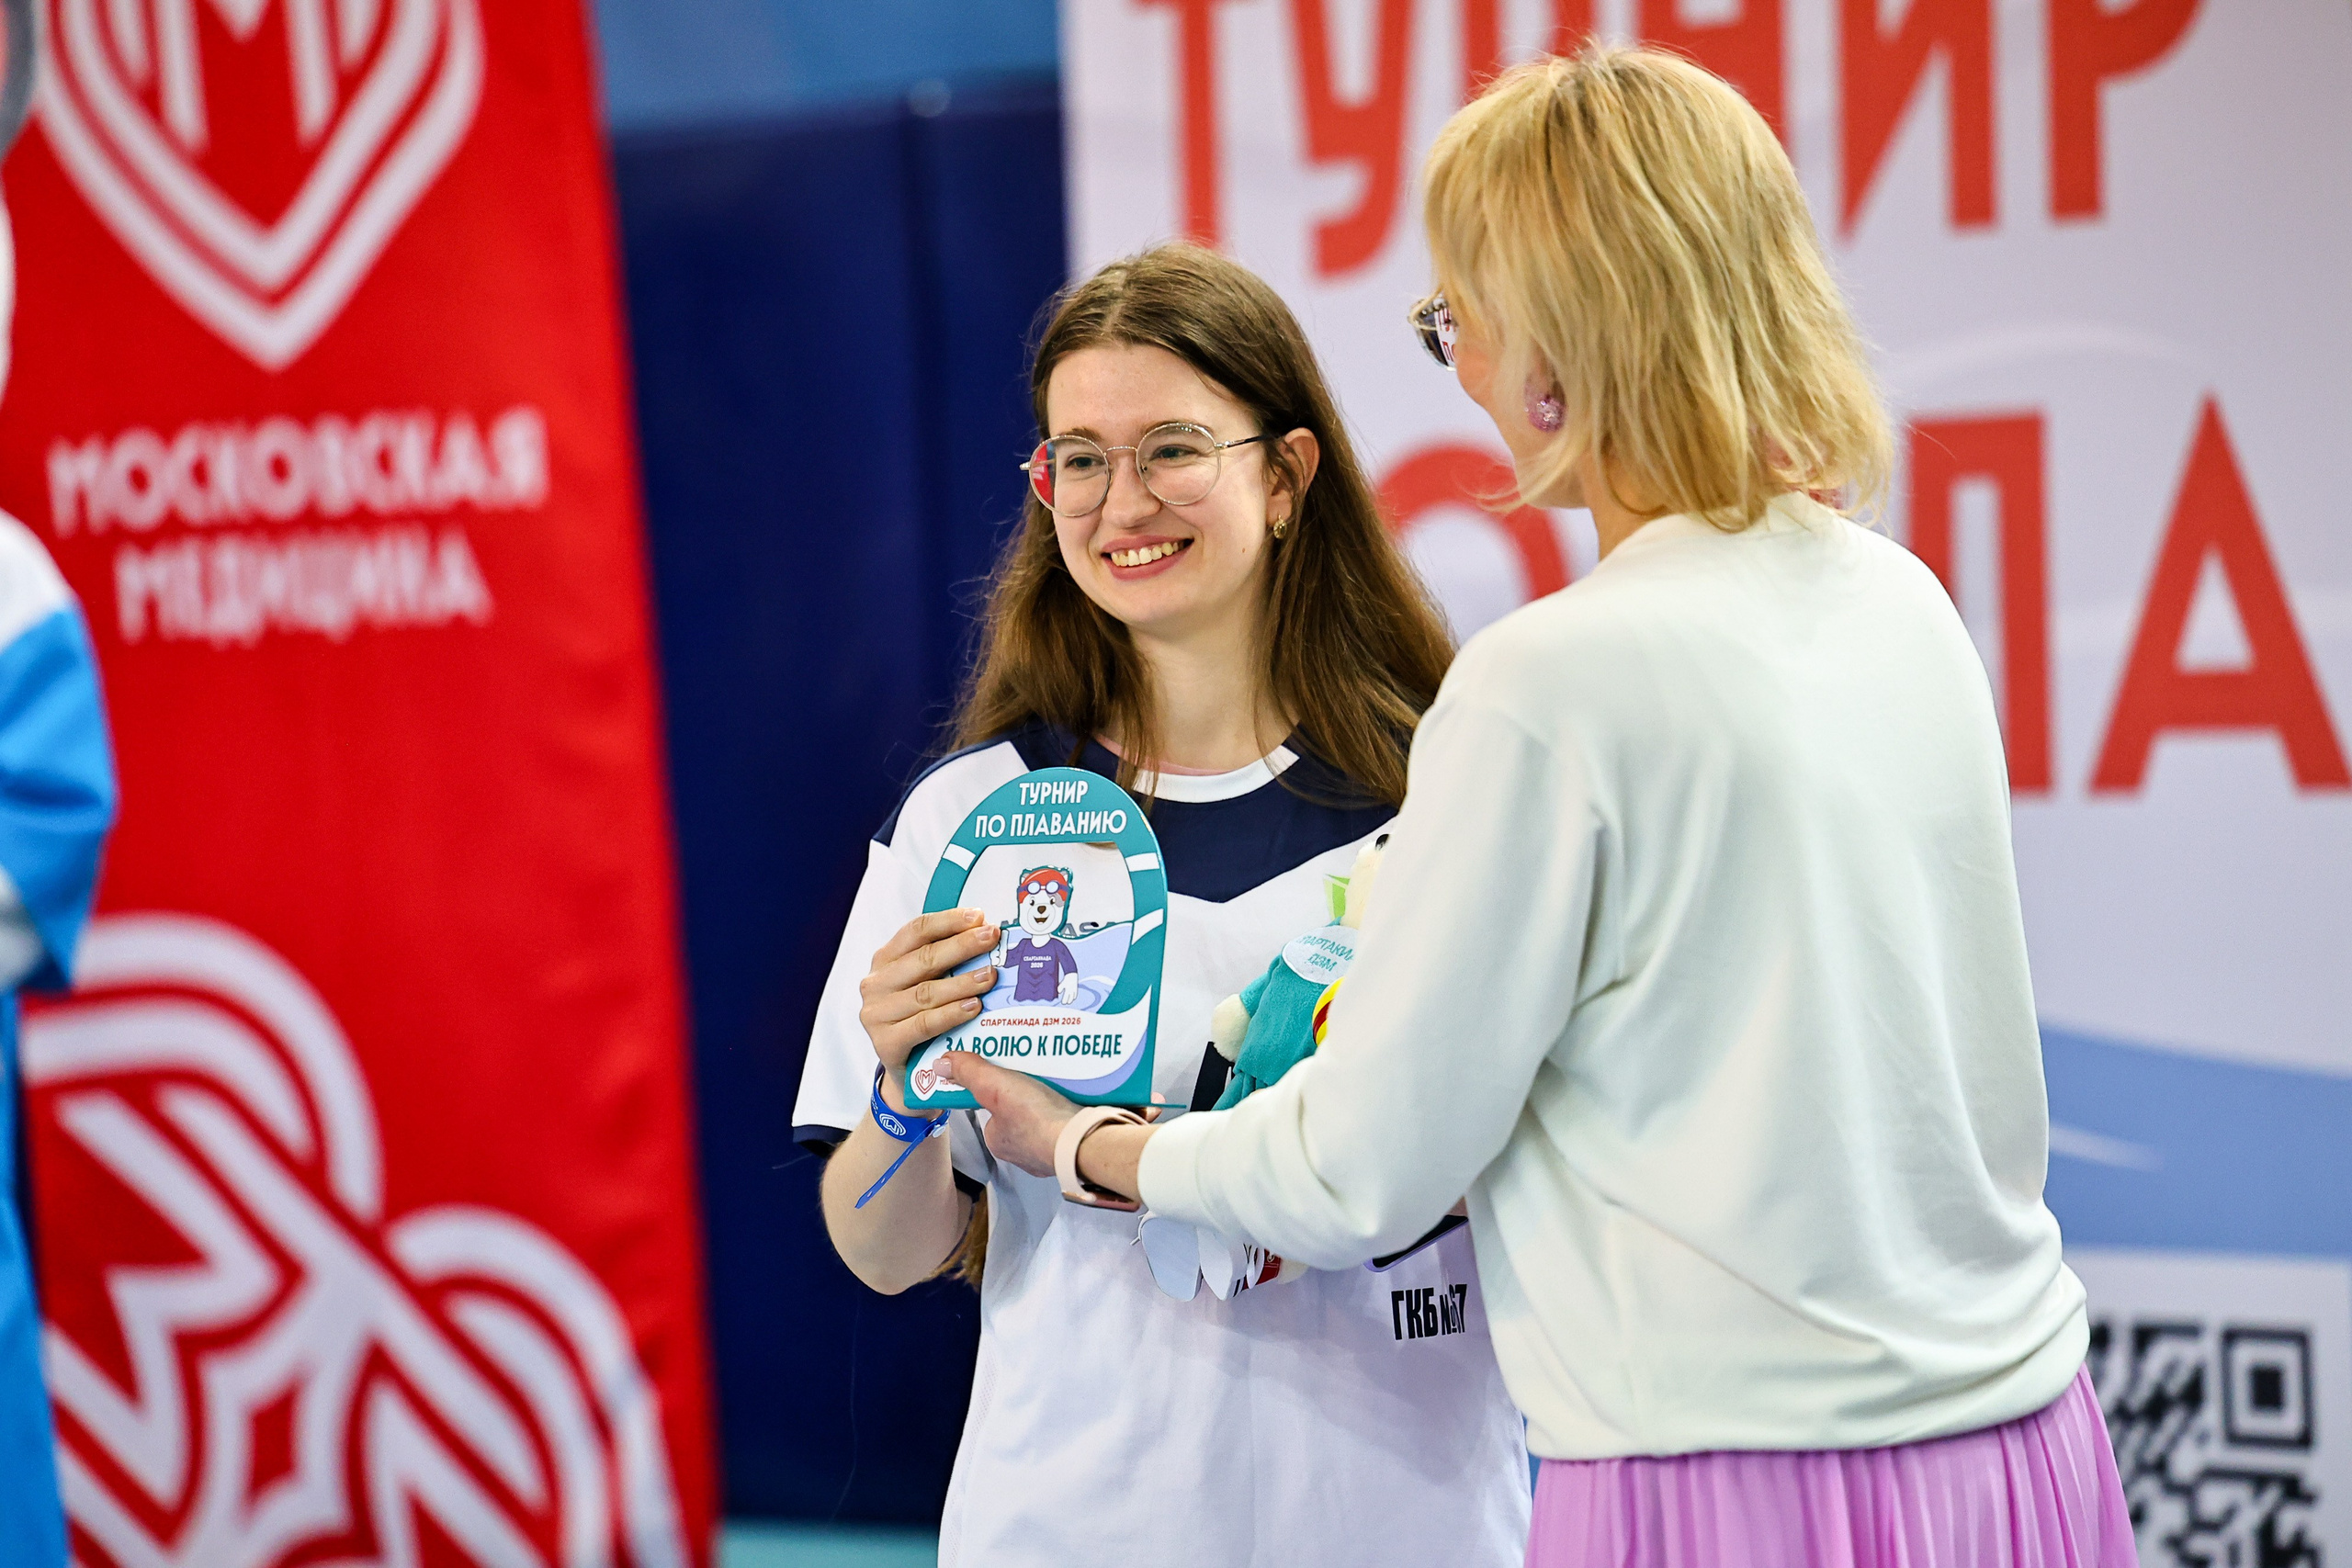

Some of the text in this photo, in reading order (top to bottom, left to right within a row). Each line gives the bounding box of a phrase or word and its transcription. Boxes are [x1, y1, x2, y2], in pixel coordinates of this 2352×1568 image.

[1126, 0, 2207, 274] ТУИР
[1019, 780, 1089, 806] ТУРНИР
[975, 809, 1127, 838] ПО ПЛАВАНИЮ
[1296, 935, 1354, 961] ПАРТАКИ
[980, 1017, 1081, 1027] СПАРТАКИАДА ДЗМ 2026
[972, 1034, 1033, 1057] ВОЛЮ
[1037, 1035, 1048, 1056] К
[1052, 1033, 1123, 1058] ПОБЕДЕ
[1391, 1287, 1439, 1340] ГКБ
